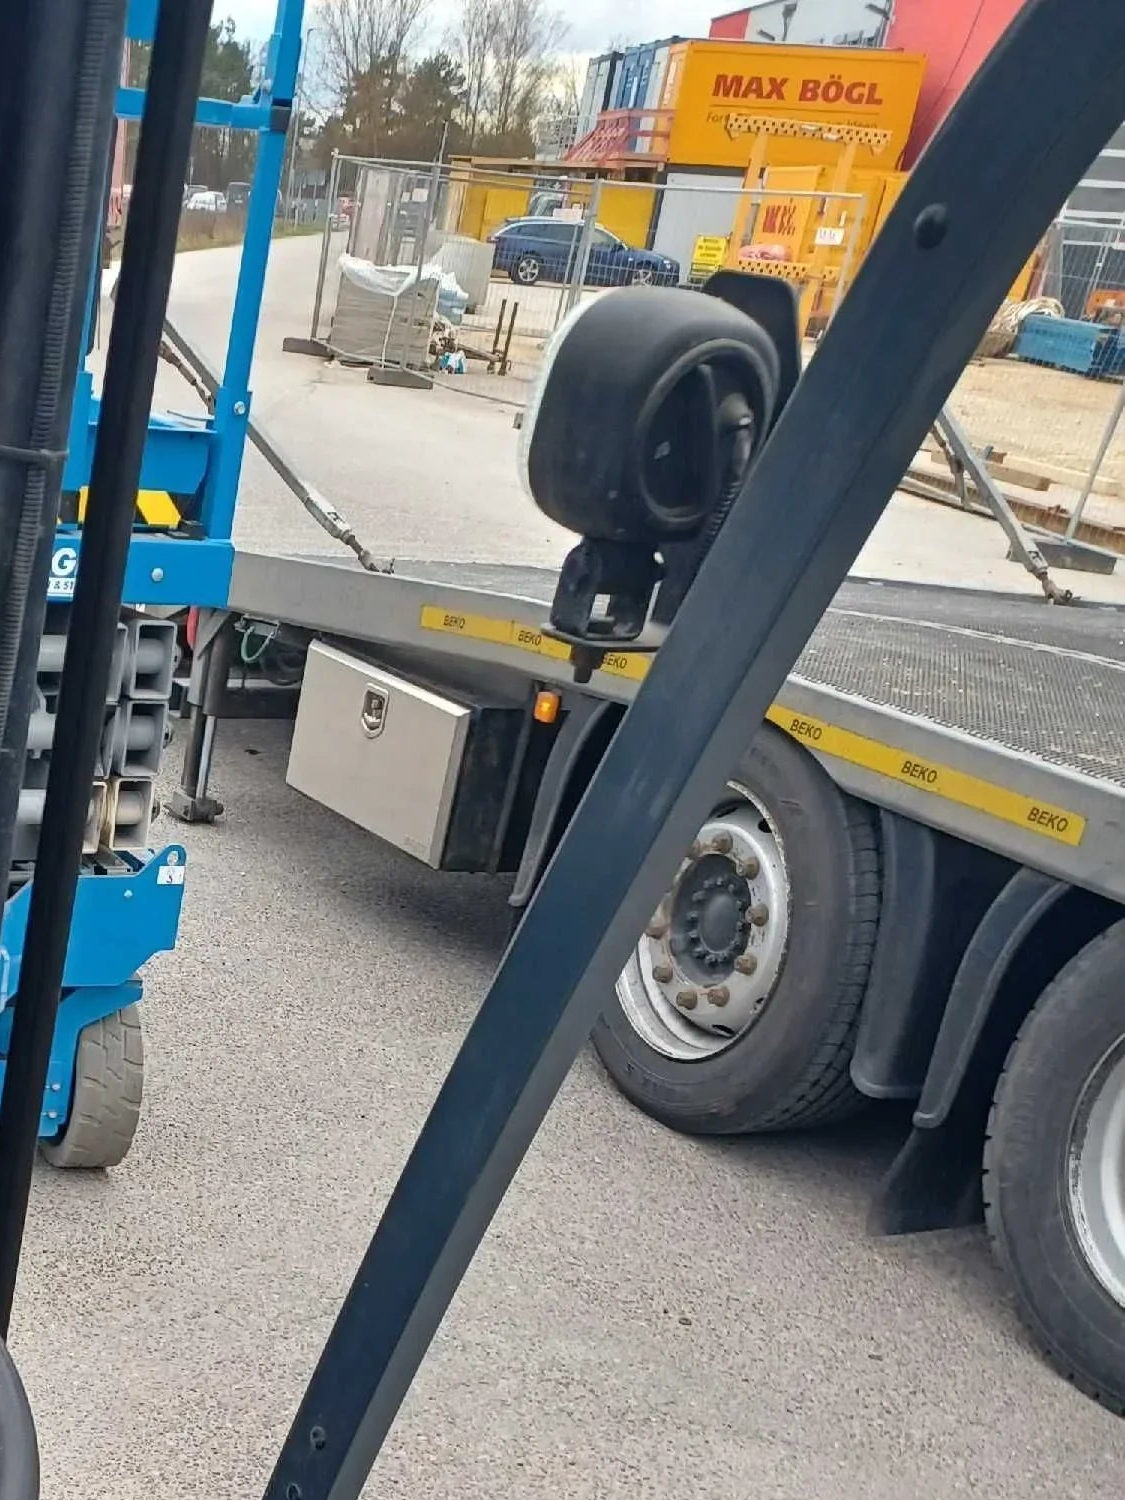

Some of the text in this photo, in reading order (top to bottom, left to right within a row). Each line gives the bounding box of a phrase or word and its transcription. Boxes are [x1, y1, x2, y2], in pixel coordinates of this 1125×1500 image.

[712, 74, 883, 105] MAX BÖGL
[443, 615, 465, 629] BEKO
[518, 630, 542, 646] BEKO
[790, 718, 823, 741] BEKO
[901, 760, 938, 784] BEKO
[1027, 807, 1069, 833] BEKO
